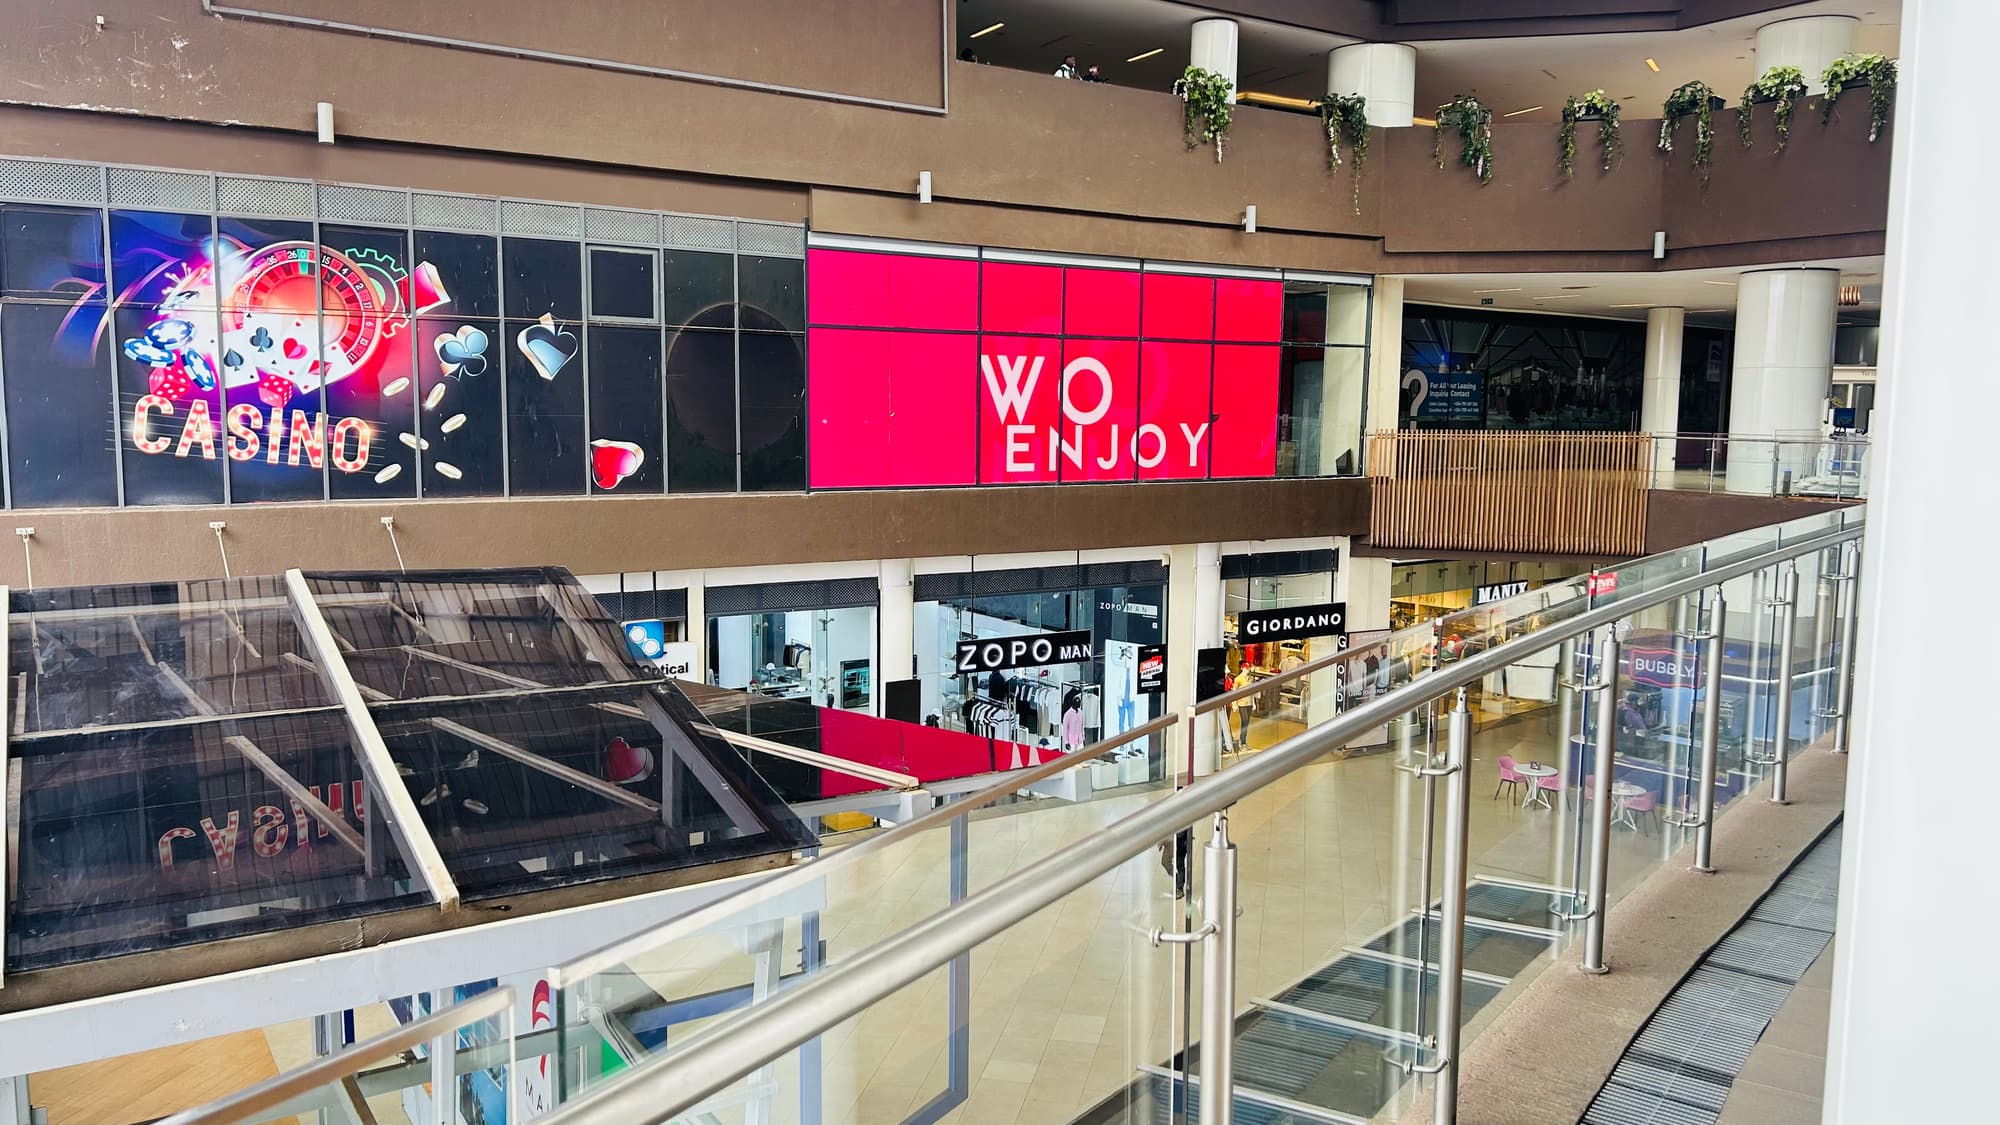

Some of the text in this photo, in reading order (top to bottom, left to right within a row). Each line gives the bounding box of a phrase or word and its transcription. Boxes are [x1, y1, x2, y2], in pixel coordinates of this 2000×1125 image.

[981, 354, 1113, 425] WO
[1430, 390, 1448, 399] Inquirie
[133, 394, 370, 472] CASINO
[1006, 422, 1209, 473] ENJOY
[1099, 602, 1122, 611] ZOPO
[1478, 582, 1528, 604] MANIX
[1247, 613, 1341, 635] GIORDANO
[959, 639, 1091, 671] ZOPO MAN
[1635, 658, 1693, 677] BUBBLY
[1336, 636, 1346, 716] GORDA
